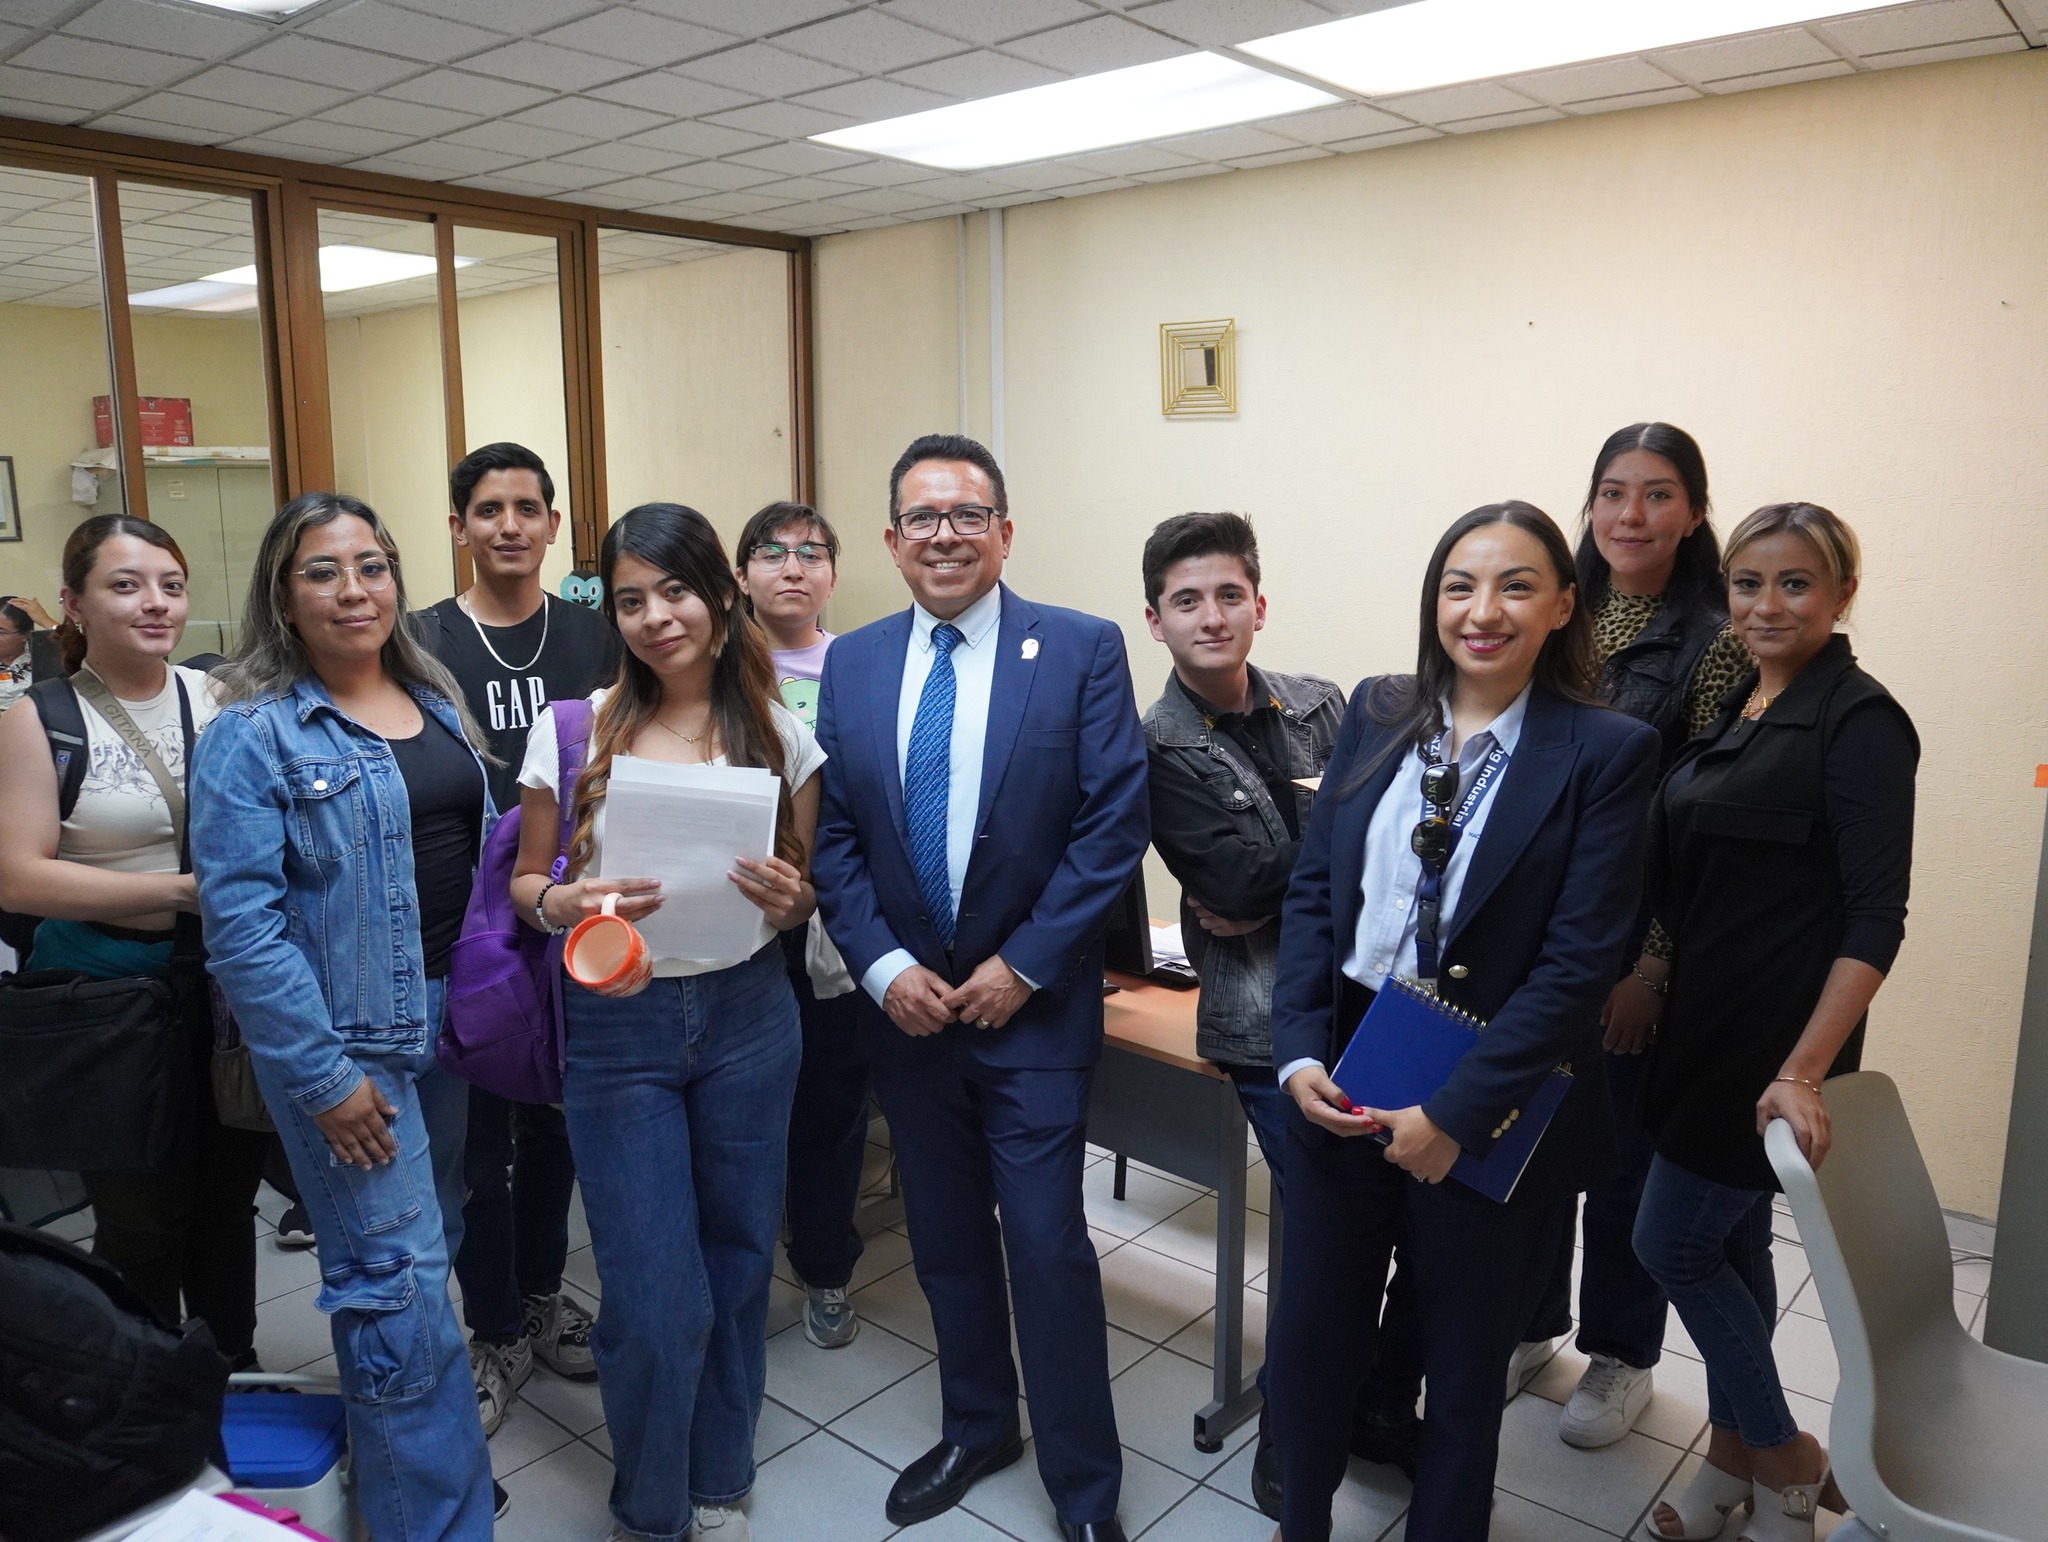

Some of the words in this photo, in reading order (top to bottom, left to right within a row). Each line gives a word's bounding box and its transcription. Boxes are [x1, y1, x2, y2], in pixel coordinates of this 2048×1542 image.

[103, 704, 151, 758] GITANA
[486, 676, 546, 731] GAP
[1452, 764, 1497, 827] Industrial
